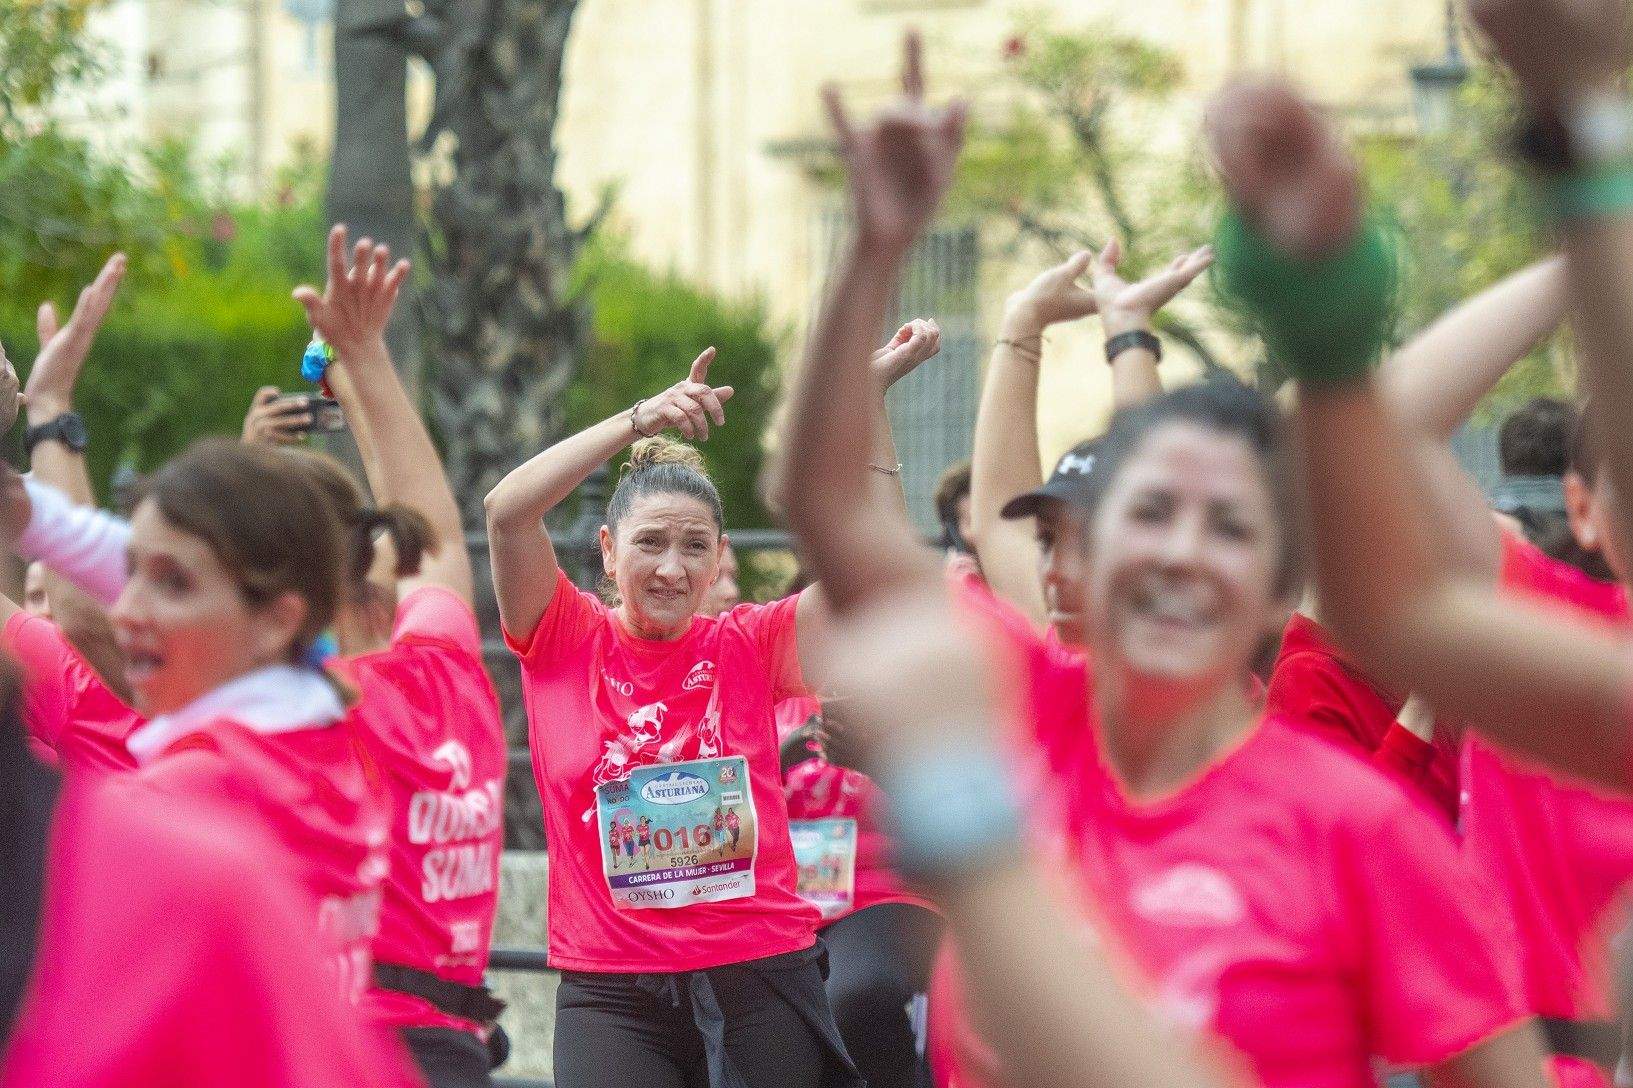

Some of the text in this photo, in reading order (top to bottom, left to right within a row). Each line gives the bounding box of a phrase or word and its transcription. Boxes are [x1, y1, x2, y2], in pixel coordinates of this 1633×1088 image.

[646, 785, 706, 799] ASTURIANA
[653, 824, 712, 851] 016
[670, 855, 699, 868] 5926
[628, 862, 735, 884] CARRERA DE LA MUJER SEVILLA
[628, 880, 742, 903] OYSHO Santander
